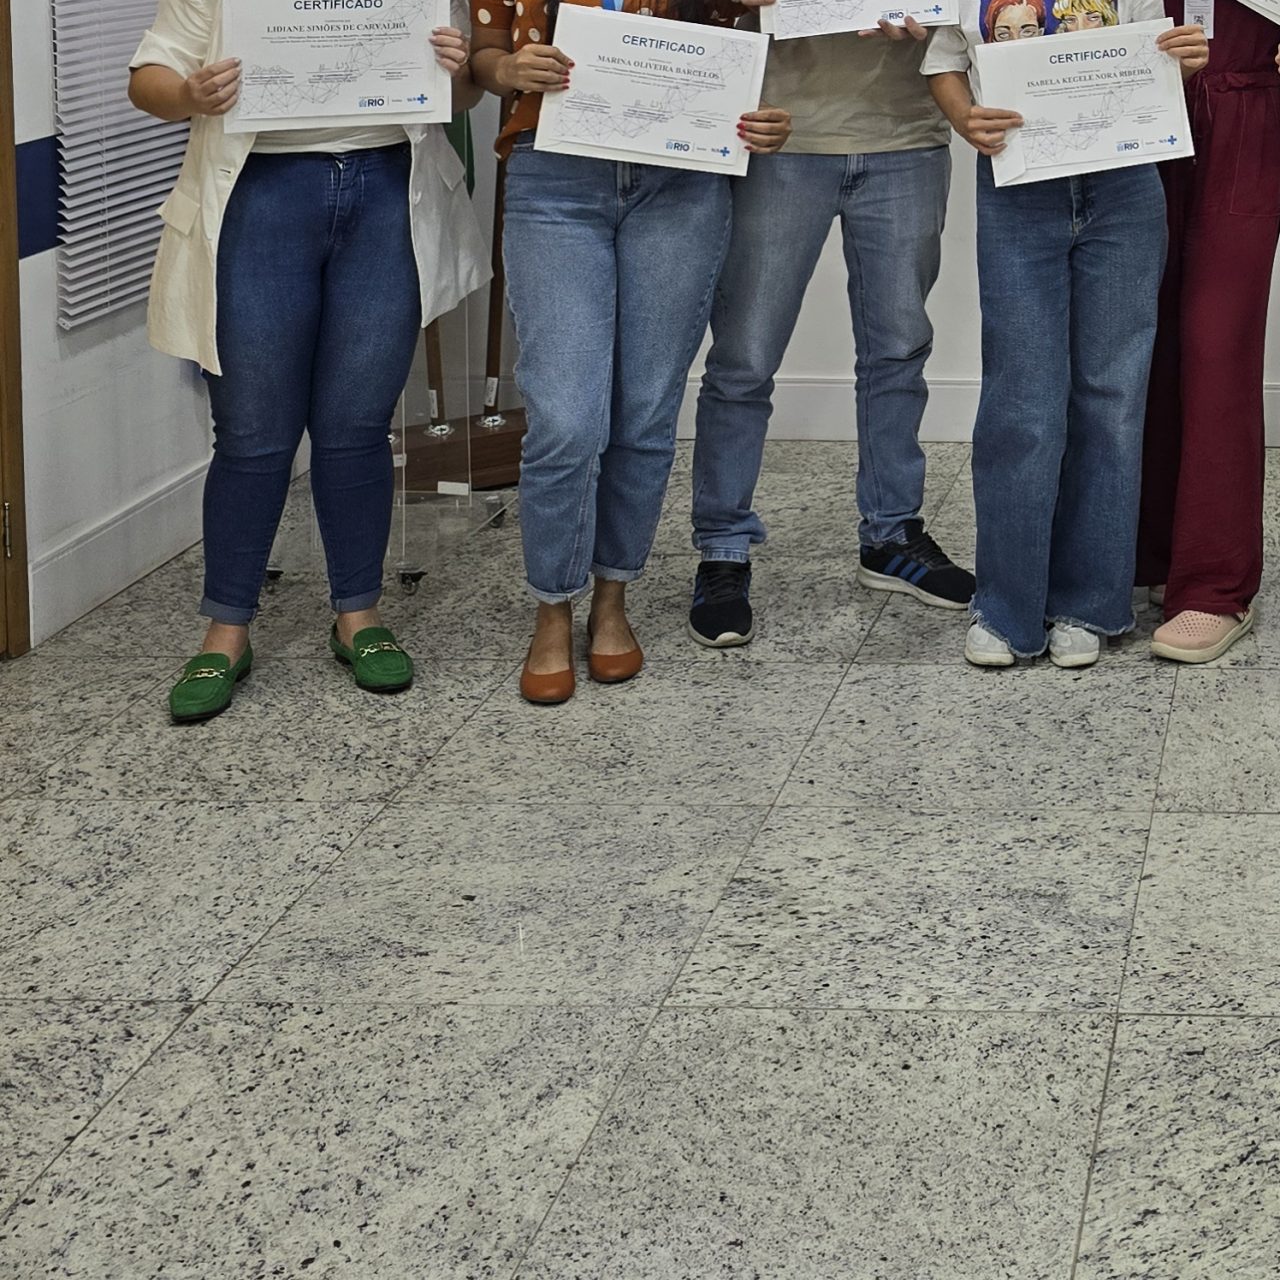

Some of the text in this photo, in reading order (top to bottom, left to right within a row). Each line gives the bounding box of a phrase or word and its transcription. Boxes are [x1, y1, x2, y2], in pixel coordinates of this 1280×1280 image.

[889, 11, 904, 20] RIO
[266, 25, 305, 33] LIDIANE
[306, 23, 341, 32] SIMÕES
[622, 34, 706, 56] CERTIFICADO
[1049, 47, 1127, 65] CERTIFICADO
[597, 54, 632, 67] MARINA
[633, 60, 673, 74] OLIVEIRA
[1027, 78, 1060, 88] ISABELA
[367, 98, 385, 107] RIO
[673, 142, 690, 152] RIO
[1123, 141, 1140, 151] RIO
